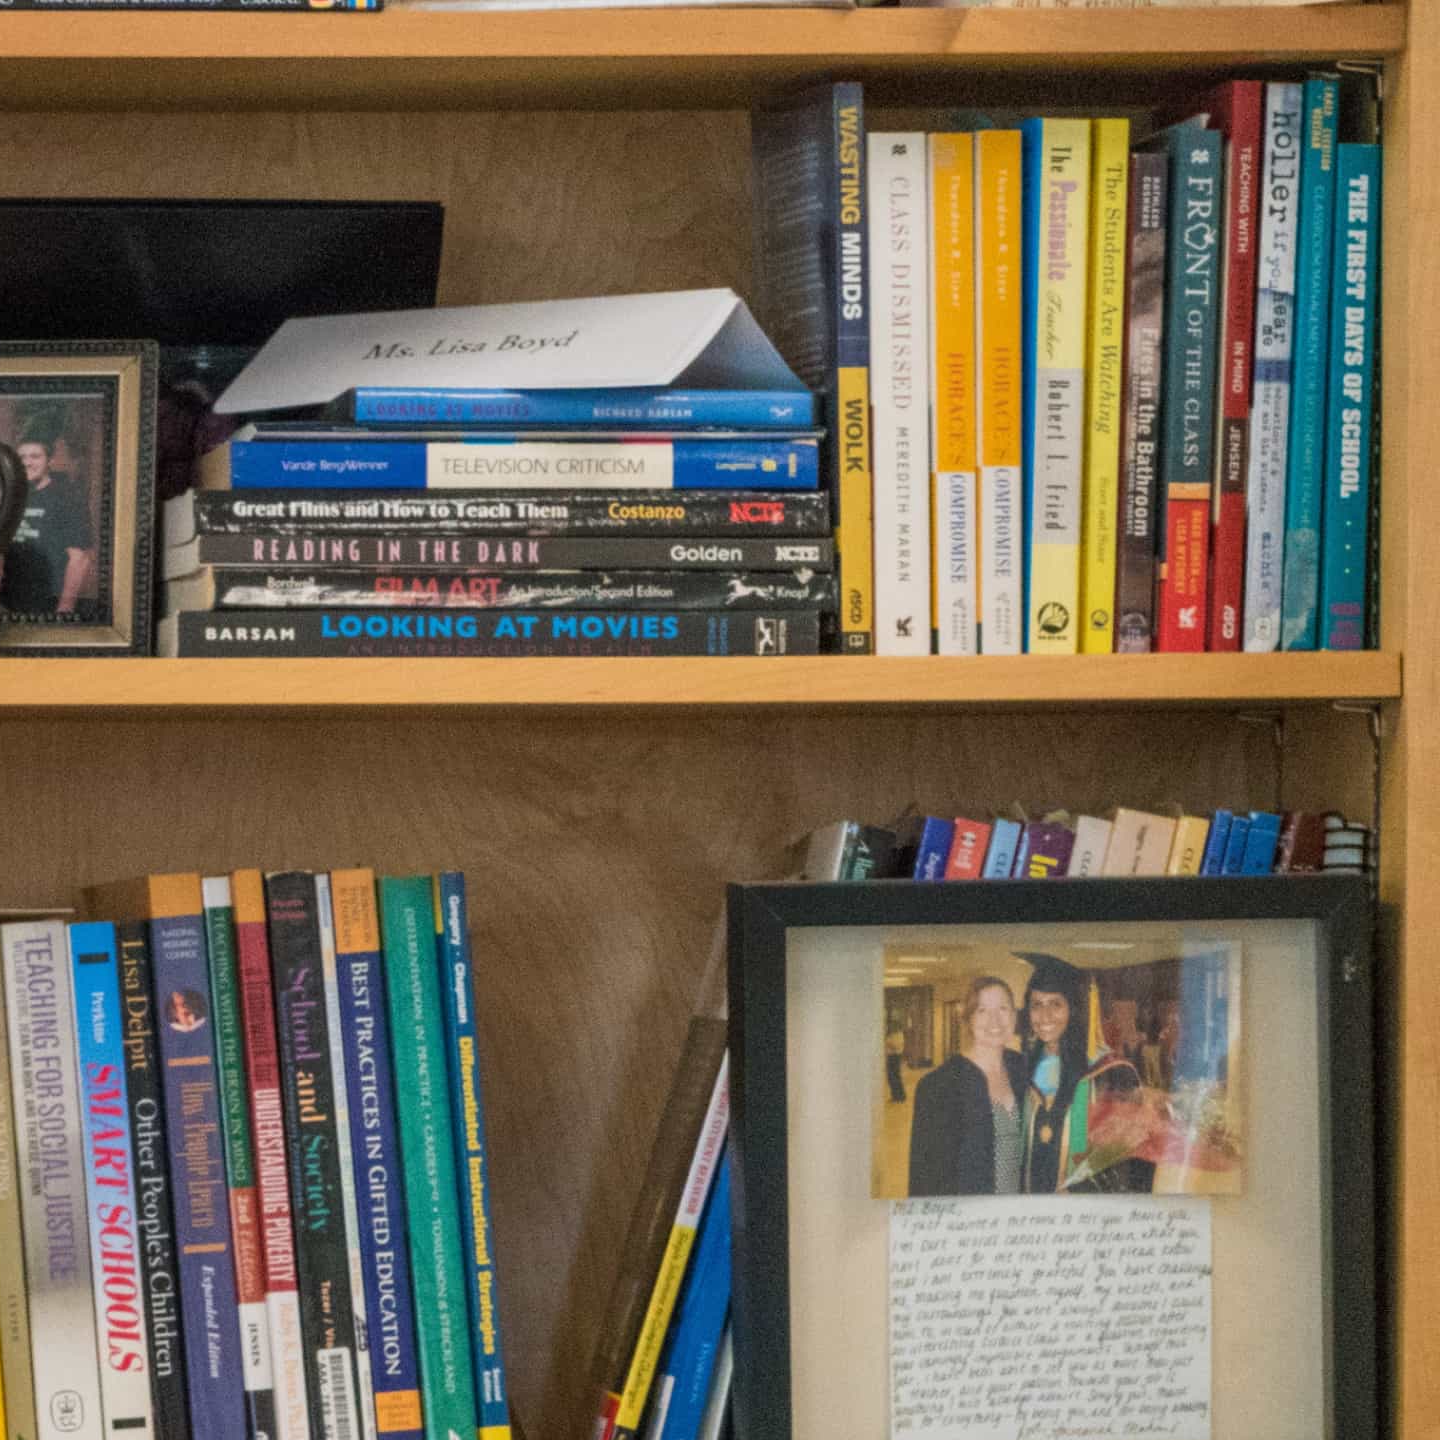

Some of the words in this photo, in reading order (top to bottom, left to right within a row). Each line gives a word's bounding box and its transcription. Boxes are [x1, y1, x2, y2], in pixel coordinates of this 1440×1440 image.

[839, 106, 860, 226] WASTING
[1348, 174, 1369, 221] THE
[843, 230, 861, 322] MINDS
[1346, 227, 1367, 300] FIRST
[362, 341, 416, 361] Ms.
[428, 337, 481, 357] Lisa
[488, 329, 579, 353] Boyd
[1345, 307, 1366, 365] DAYS
[1343, 372, 1362, 404] OF
[442, 458, 548, 475] TELEVISION
[555, 458, 645, 475] CRITICISM
[845, 399, 863, 473] WOLK
[1340, 409, 1361, 498] SCHOOL
[253, 539, 361, 563] READING
[377, 540, 401, 563] IN
[418, 540, 461, 563] THE
[478, 540, 541, 563] DARK
[670, 545, 742, 563] Golden
[205, 628, 295, 641] BARSAM
[322, 615, 485, 638] LOOKING
[496, 616, 537, 638] AT
[552, 616, 679, 638] MOVIES
[350, 962, 370, 1008] BEST
[356, 1013, 382, 1127] PRACTICES
[85, 1063, 125, 1191] SMART
[367, 1136, 384, 1159] IN
[367, 1164, 388, 1244] GIFTED
[98, 1201, 143, 1373] SCHOOLS
[374, 1250, 402, 1376] EDUCATION
